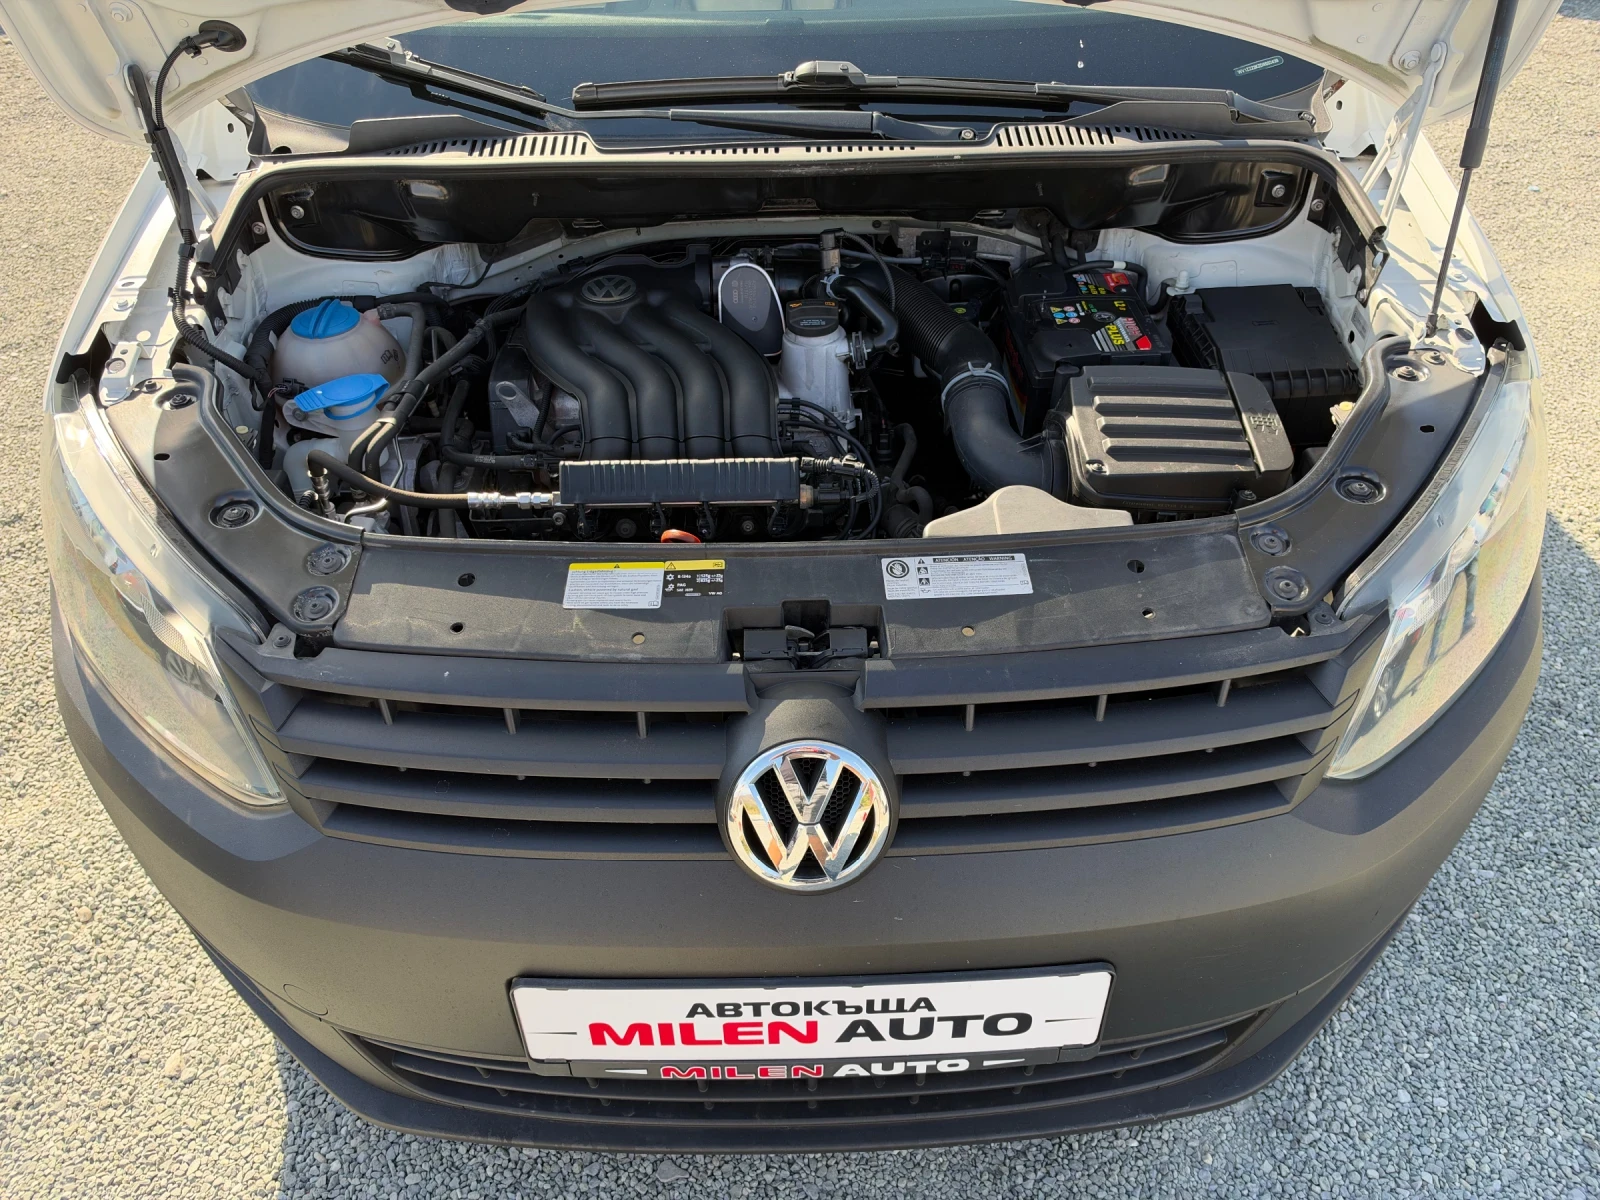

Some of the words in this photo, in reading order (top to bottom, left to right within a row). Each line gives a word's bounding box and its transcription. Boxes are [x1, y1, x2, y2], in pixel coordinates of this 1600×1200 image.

[1105, 323, 1125, 345] PLUS
[685, 996, 937, 1018] АВТОКЪЩА
[589, 1021, 819, 1046] MILEN
[835, 1012, 1033, 1042] AUTO
[660, 1064, 824, 1080] MILEN
[834, 1058, 971, 1076] AUTO
